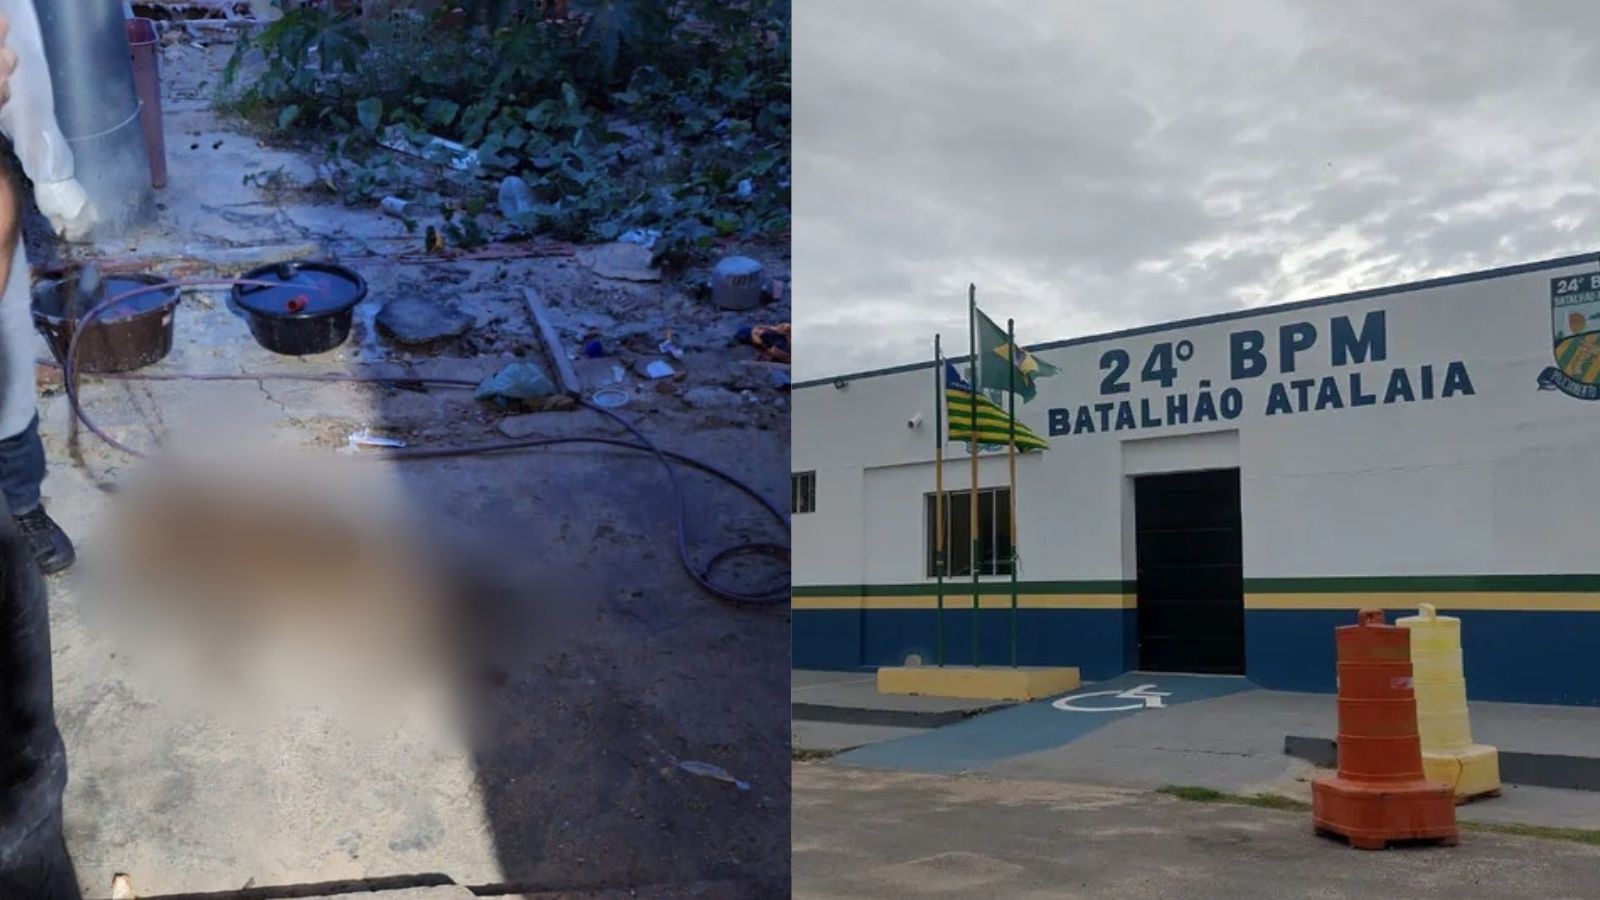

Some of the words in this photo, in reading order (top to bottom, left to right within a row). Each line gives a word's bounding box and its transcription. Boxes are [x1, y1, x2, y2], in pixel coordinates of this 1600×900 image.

[1099, 339, 1194, 396] 24º
[1229, 309, 1388, 381] BPM
[1047, 379, 1243, 437] BATALHÃO
[1265, 360, 1476, 416] ATALAIA
